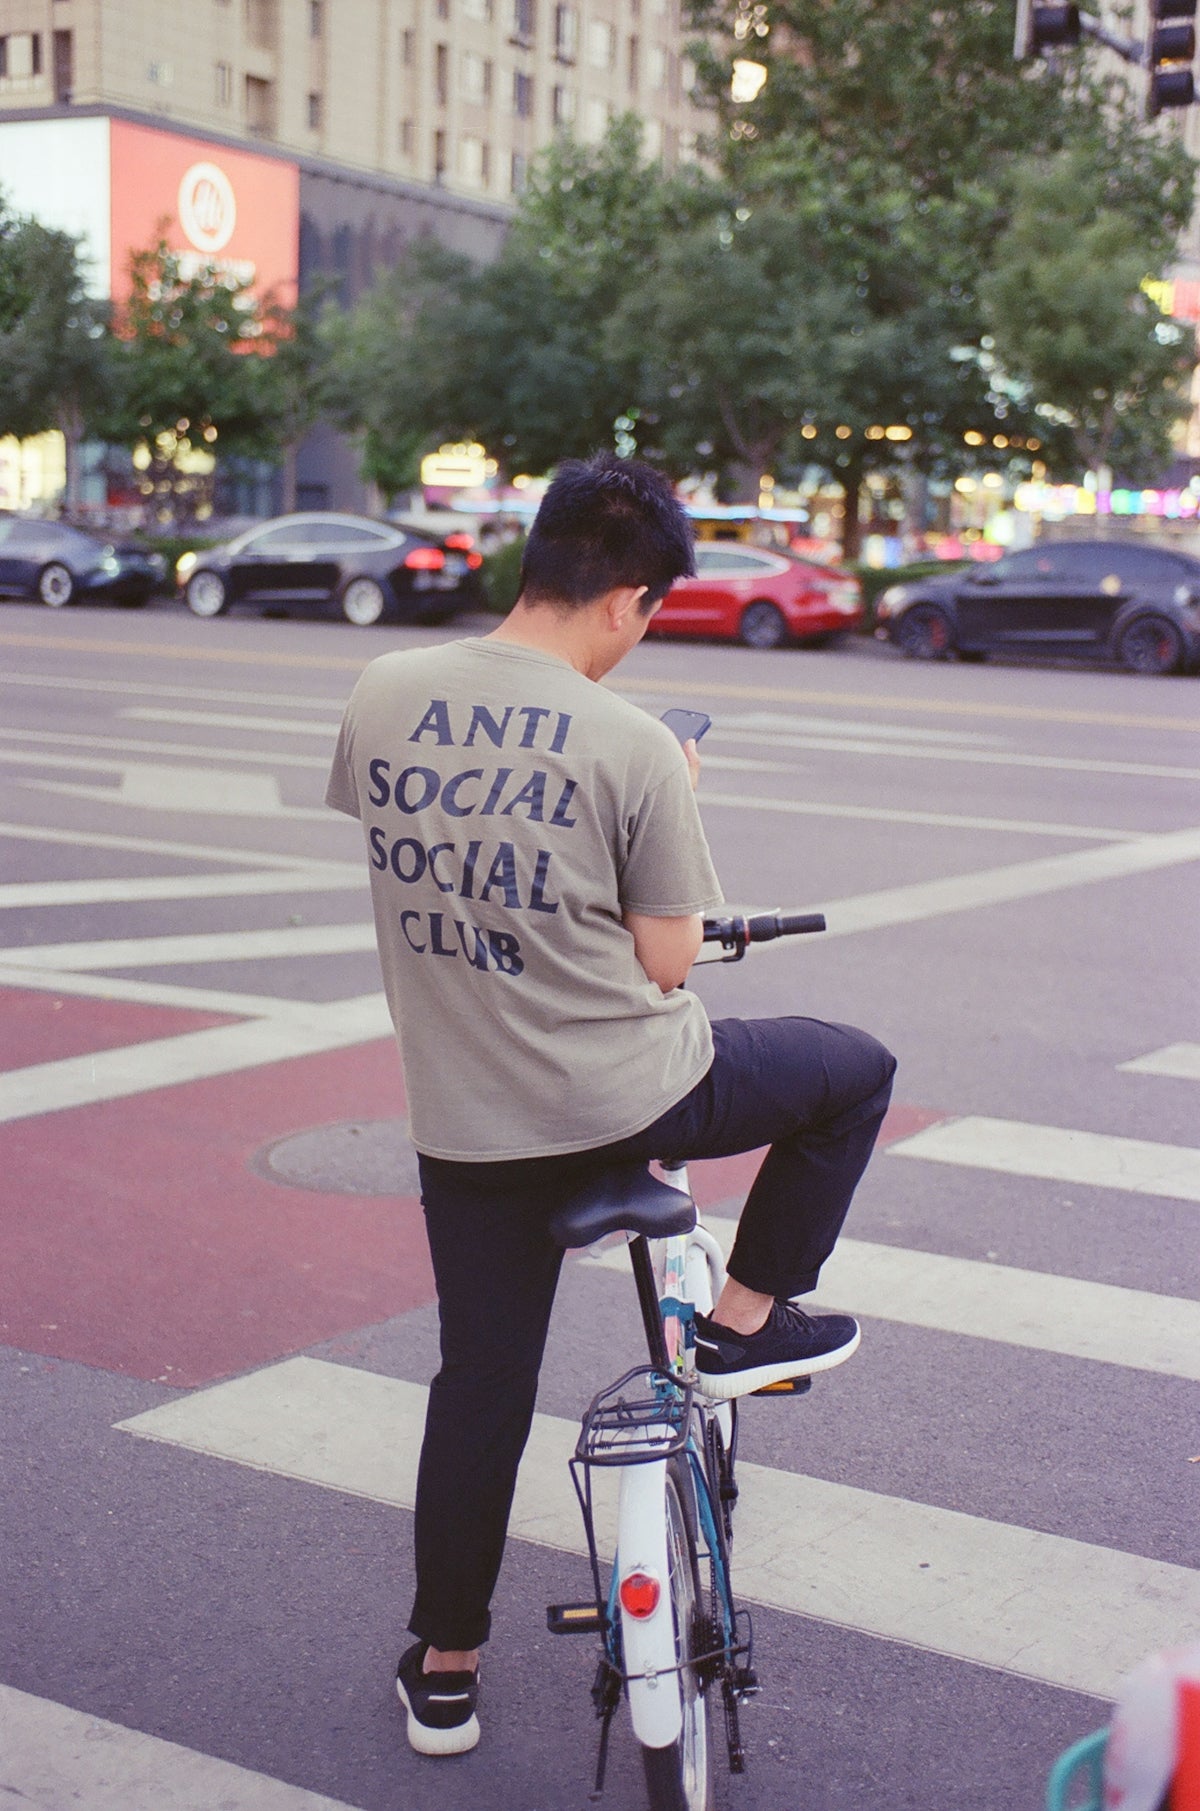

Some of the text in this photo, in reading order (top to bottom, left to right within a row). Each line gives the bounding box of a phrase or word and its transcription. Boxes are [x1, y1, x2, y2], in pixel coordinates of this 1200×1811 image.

[407, 699, 573, 754] ANTI
[368, 758, 579, 828] SOCIAL
[369, 826, 560, 914] SOCIAL
[400, 910, 525, 976] CLUB
